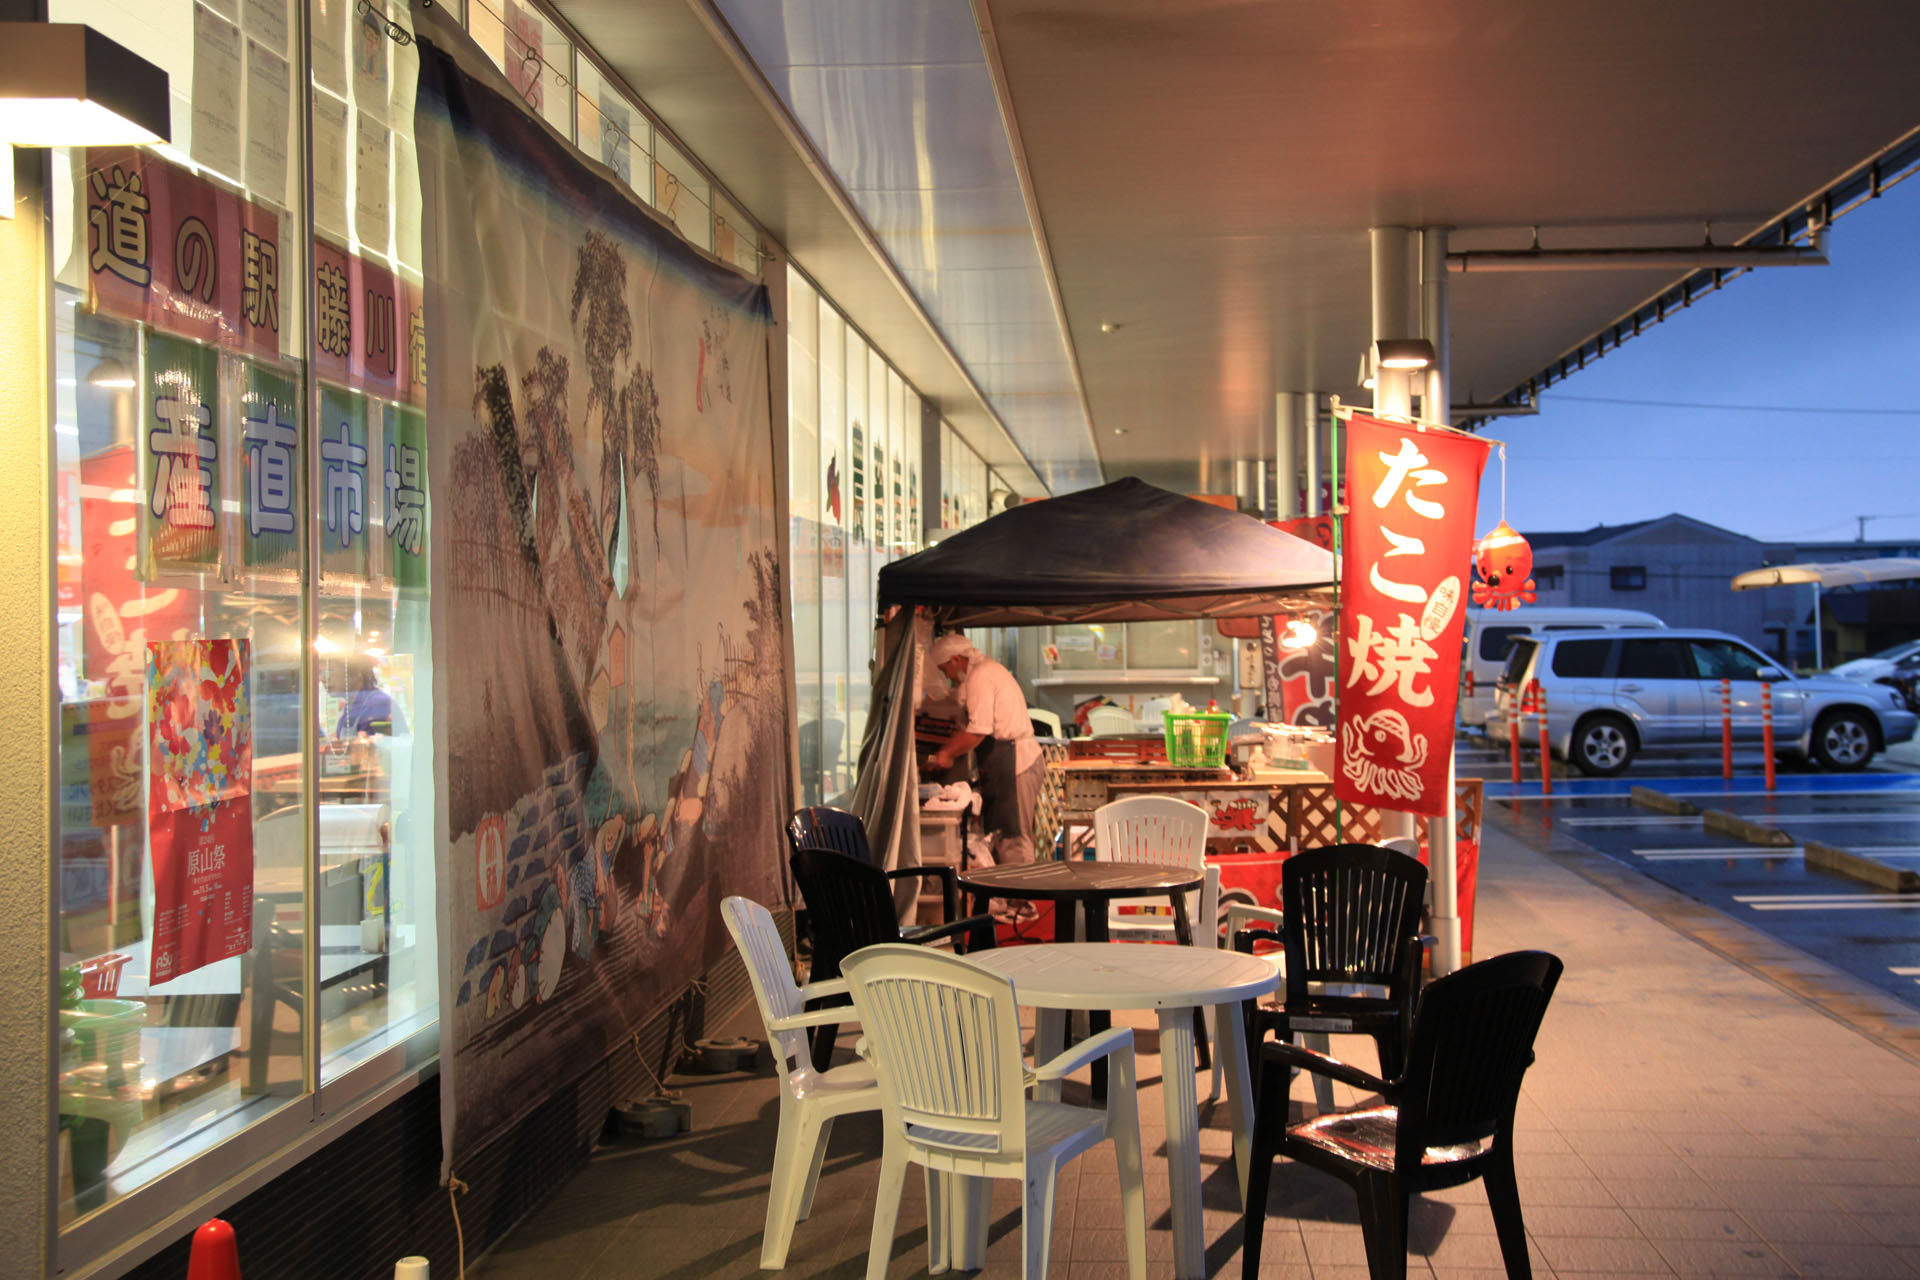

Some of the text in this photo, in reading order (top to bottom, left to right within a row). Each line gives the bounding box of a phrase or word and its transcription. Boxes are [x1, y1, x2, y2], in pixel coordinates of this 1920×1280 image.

[90, 166, 279, 332] 道の駅
[150, 395, 426, 556] 産直市場
[1347, 438, 1449, 708] たこ焼
